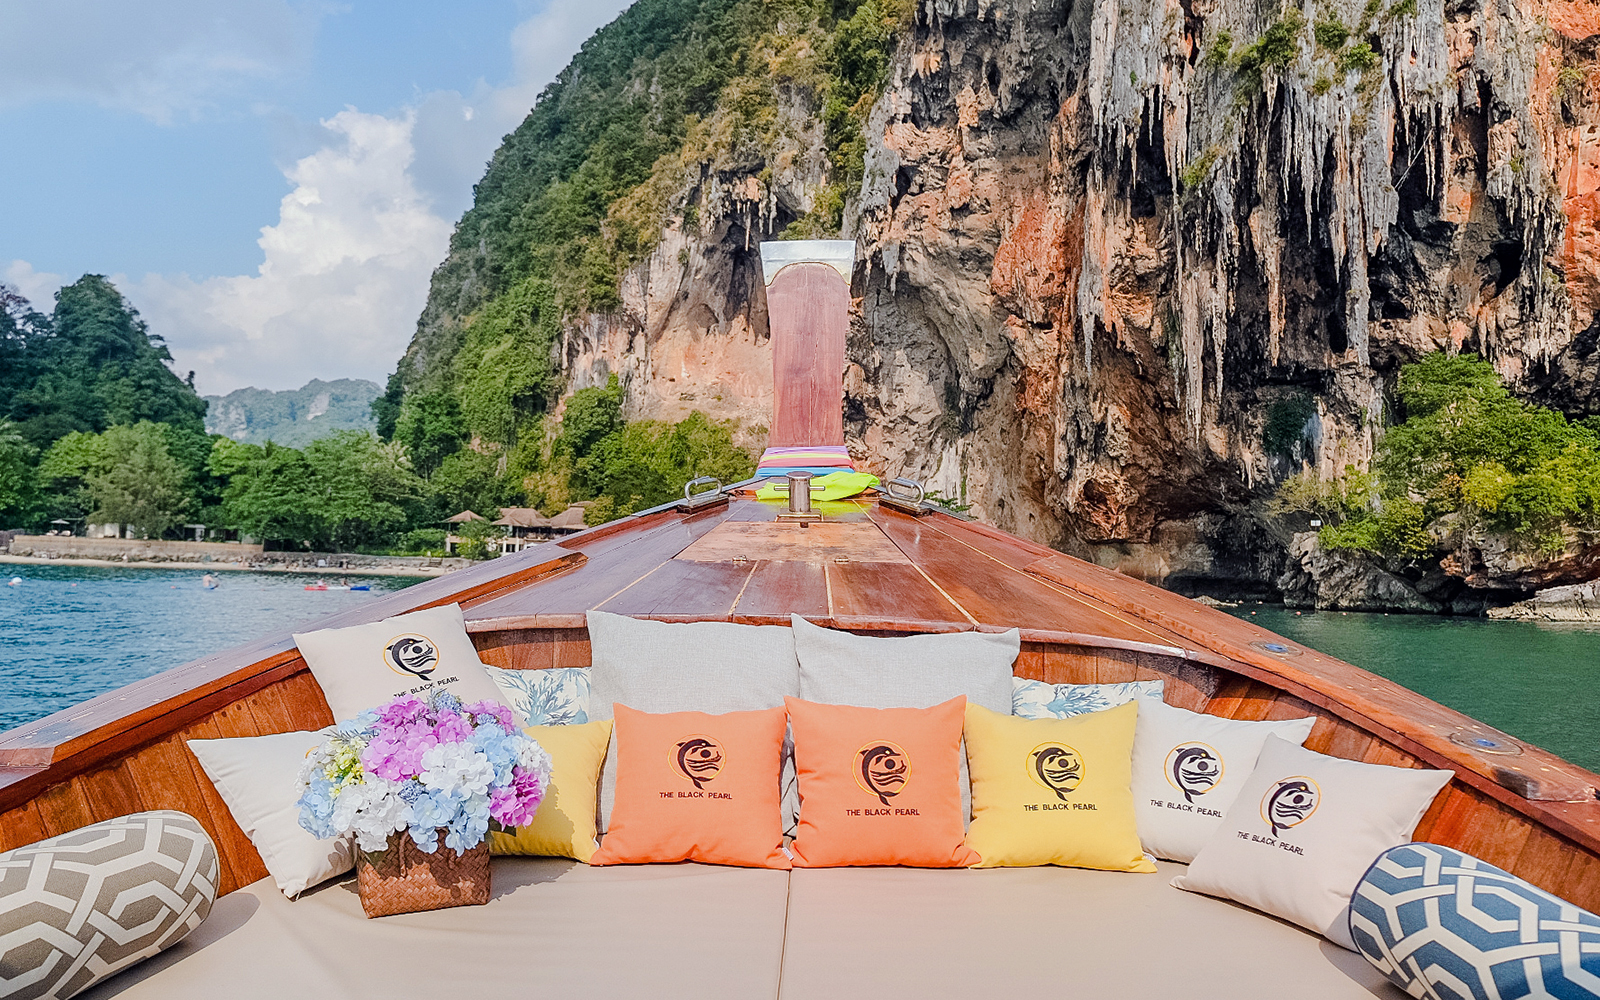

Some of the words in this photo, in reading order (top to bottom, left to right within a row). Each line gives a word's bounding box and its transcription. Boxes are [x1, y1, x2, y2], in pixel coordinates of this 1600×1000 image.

[410, 683, 435, 694] BLACK
[437, 675, 460, 686] PEARL
[659, 791, 674, 799] THE
[677, 791, 704, 799] BLACK
[708, 792, 733, 800] PEARL
[846, 809, 861, 817] THE
[864, 808, 891, 816] BLACK
[895, 808, 920, 816] PEARL
[1023, 804, 1039, 812] THE
[1042, 803, 1069, 811] BLACK
[1072, 803, 1098, 811] PEARL
[1150, 799, 1164, 808] THE
[1167, 802, 1193, 812] BLACK
[1196, 807, 1223, 818] PEARL
[1237, 831, 1250, 840] THE
[1251, 835, 1277, 846] BLACK
[1279, 841, 1305, 856] PEARL
